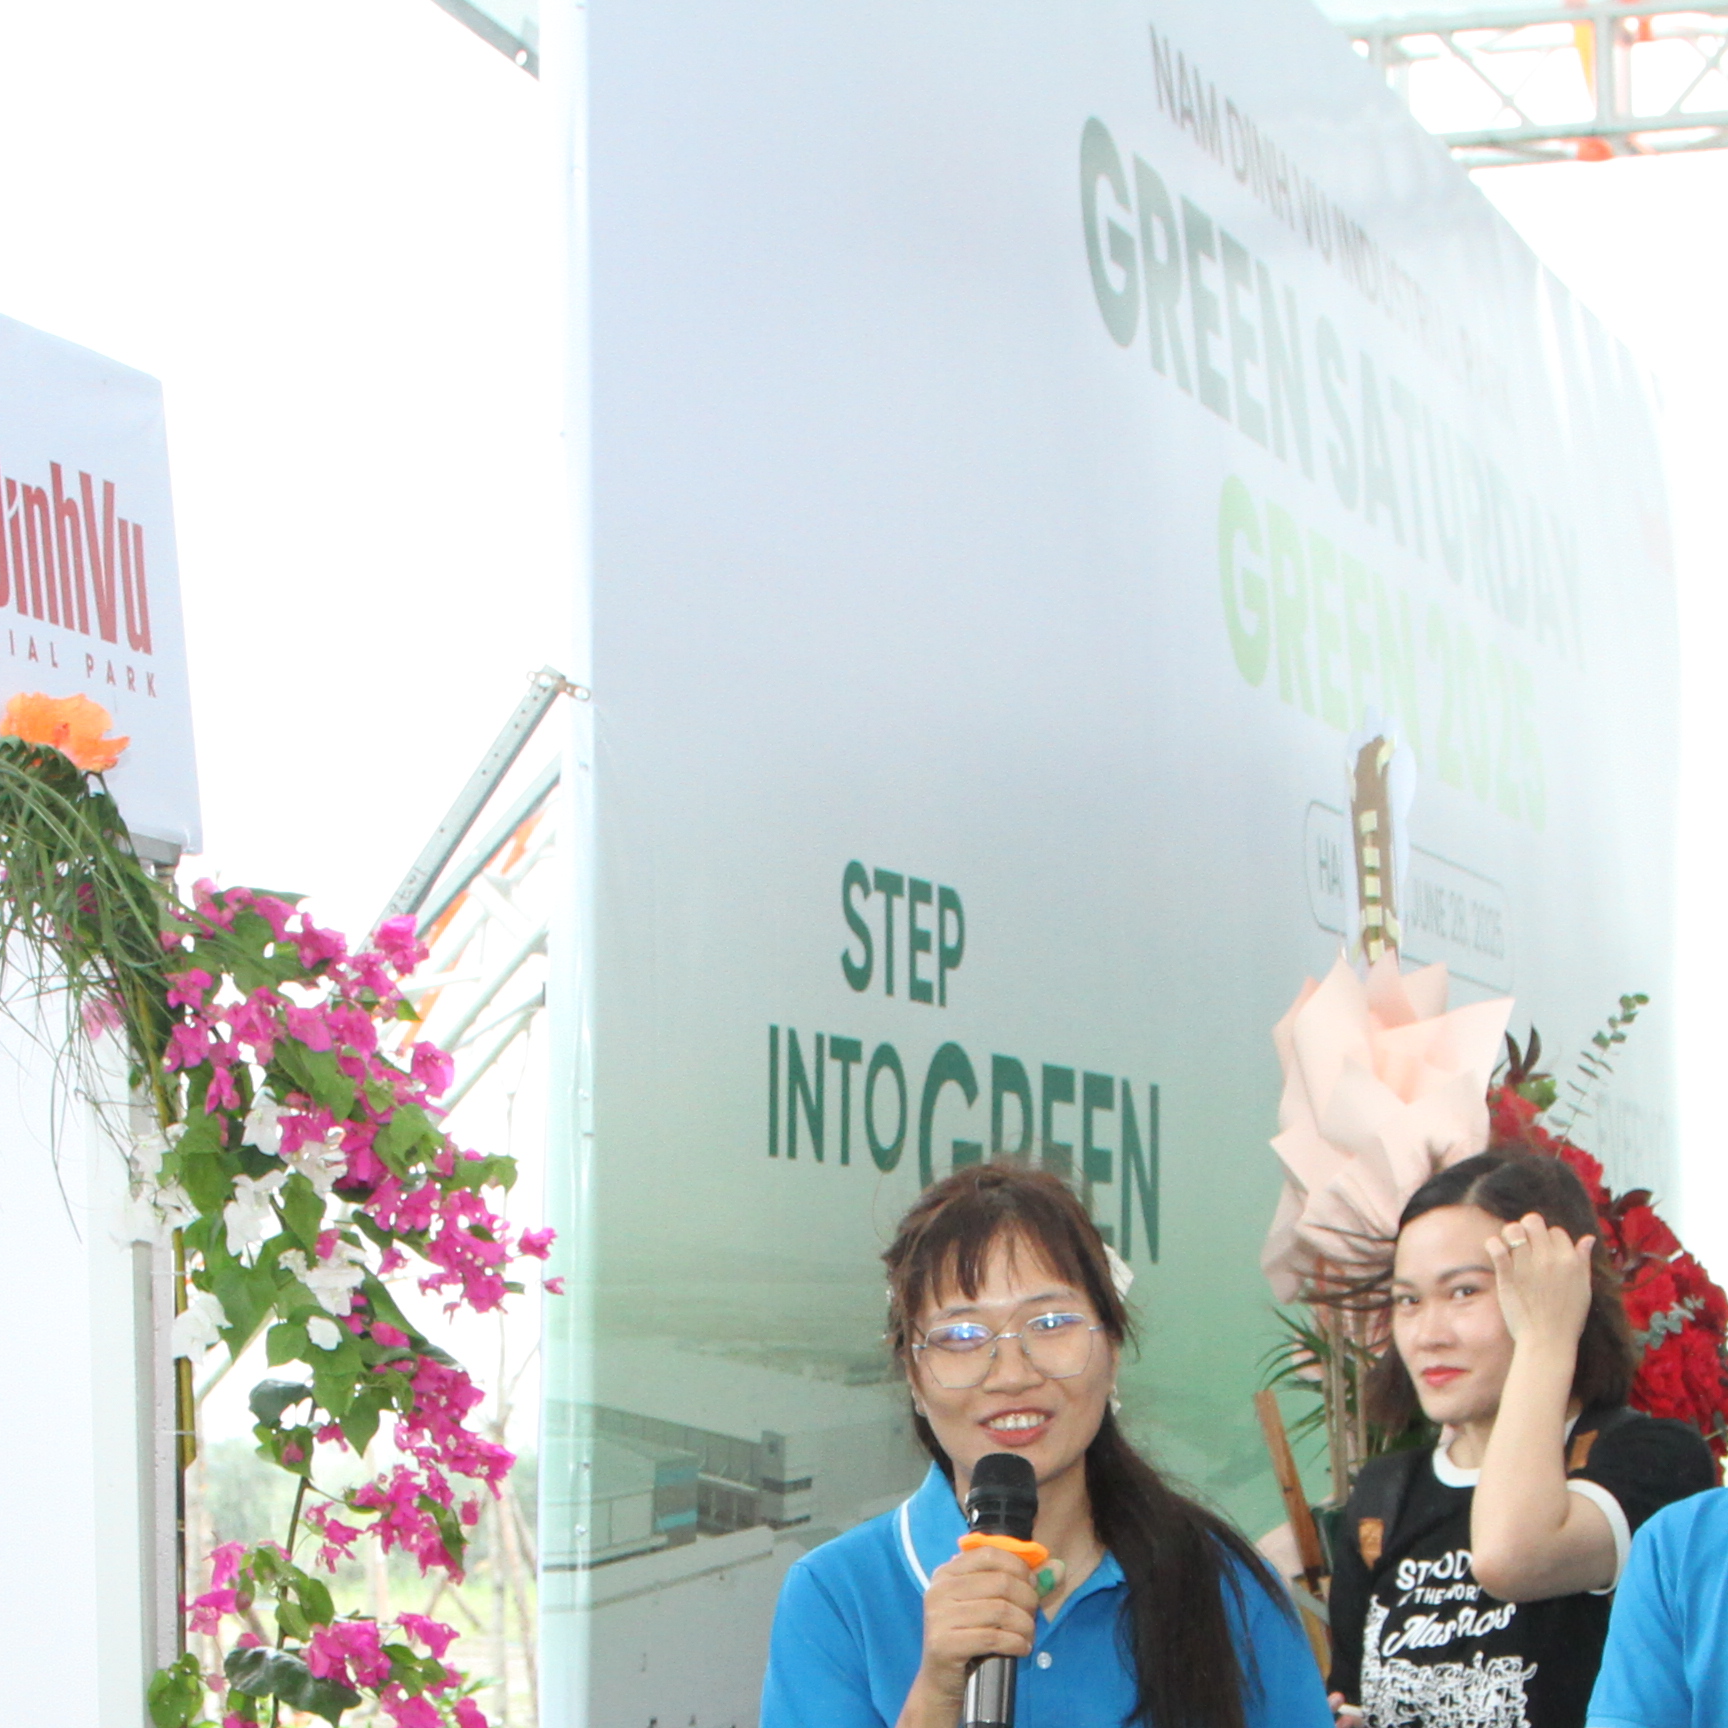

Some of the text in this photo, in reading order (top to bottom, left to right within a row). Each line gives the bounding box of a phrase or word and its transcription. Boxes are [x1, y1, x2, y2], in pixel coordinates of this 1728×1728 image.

[1080, 115, 1315, 482] GREEN
[85, 653, 158, 698] PARK
[841, 859, 966, 1007] STEP
[768, 1024, 908, 1174] INTO
